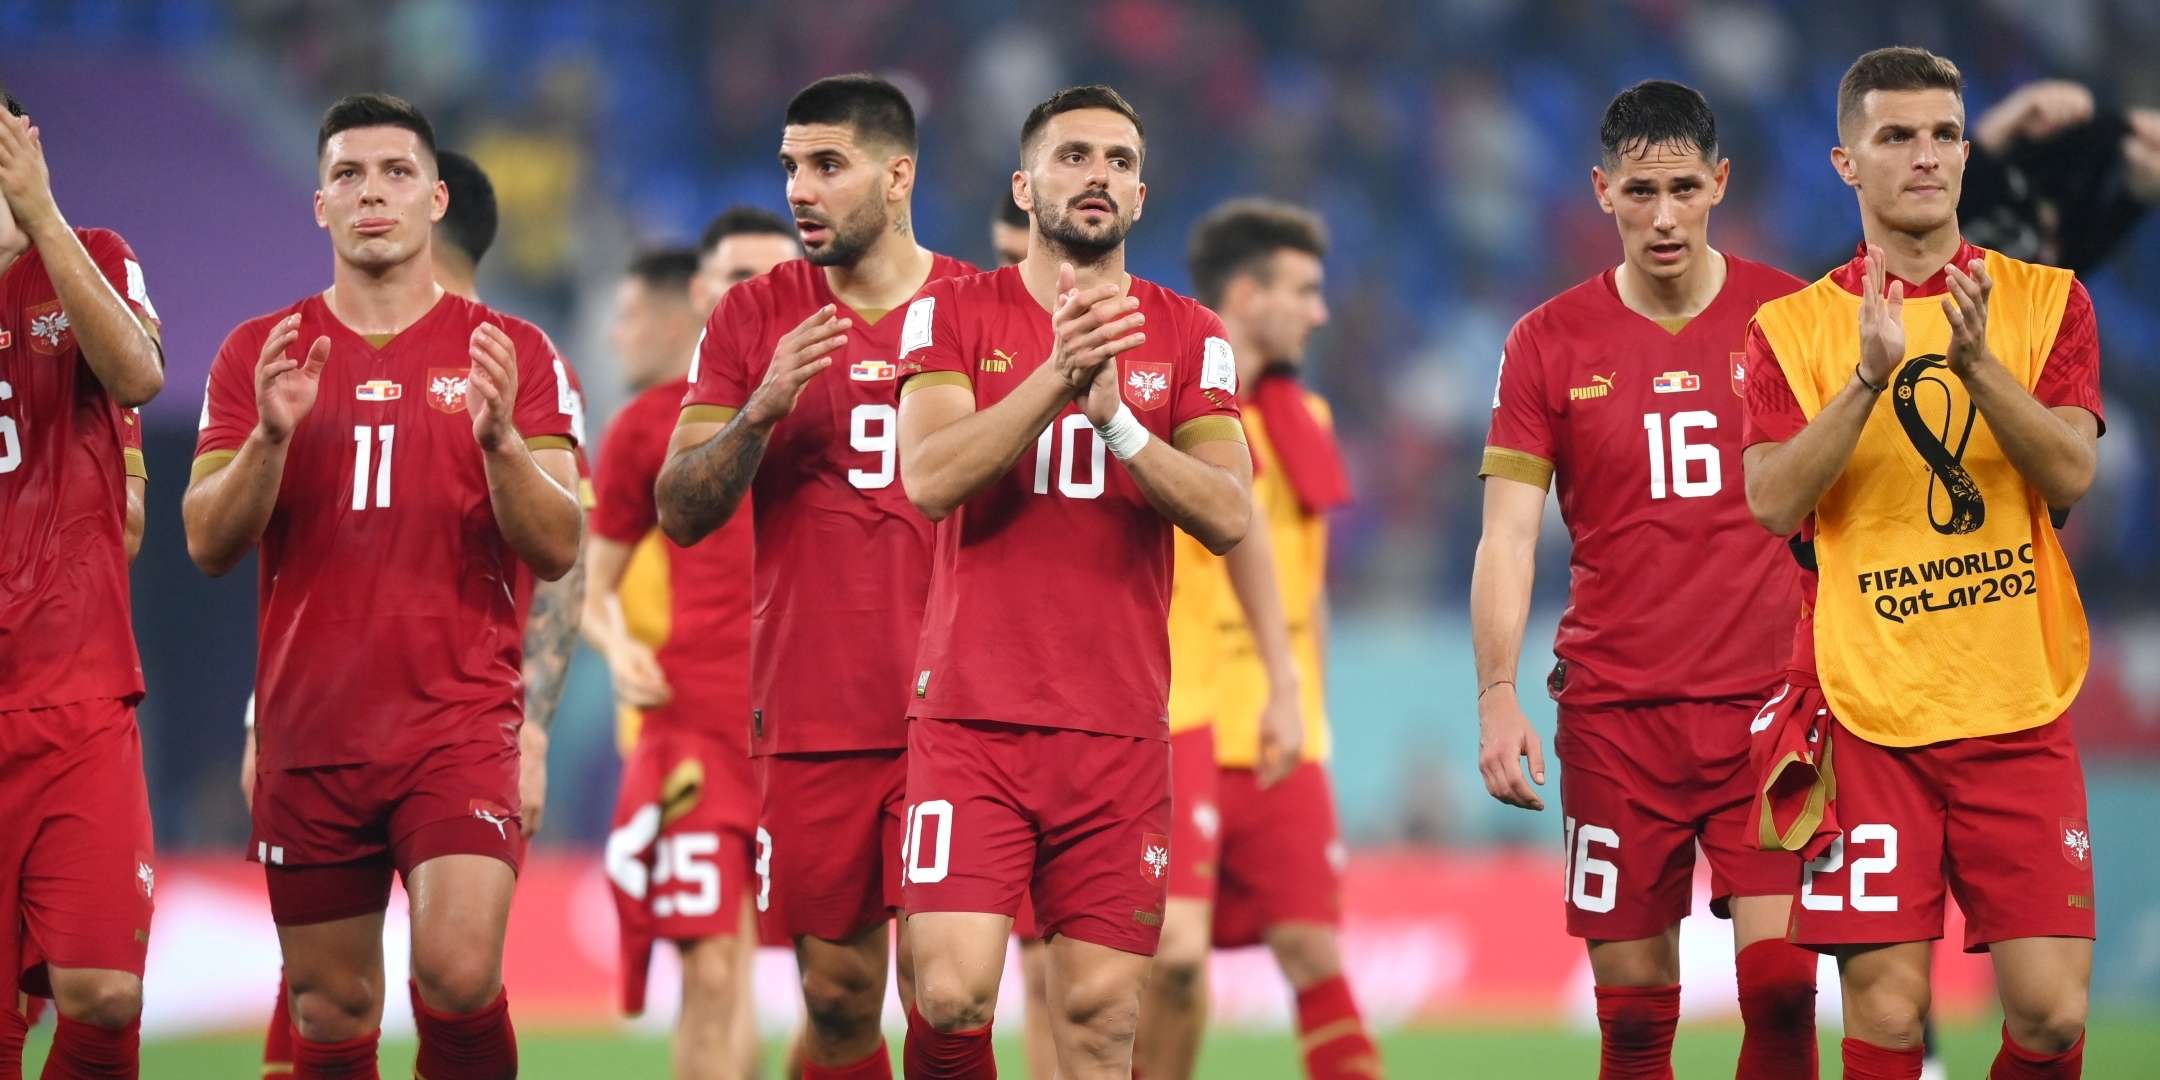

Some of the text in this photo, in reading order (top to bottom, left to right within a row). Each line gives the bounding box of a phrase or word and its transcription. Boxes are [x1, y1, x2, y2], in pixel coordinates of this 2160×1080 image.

[1570, 385, 1607, 400] PUMA
[352, 424, 395, 510] 11
[848, 404, 897, 489] 9
[1034, 414, 1106, 499] 10
[1643, 410, 1722, 499] 16
[1858, 566, 1918, 593] FIFA
[1919, 549, 2014, 582] WORLD
[1564, 816, 1620, 913] 16
[1801, 823, 1898, 912] 22
